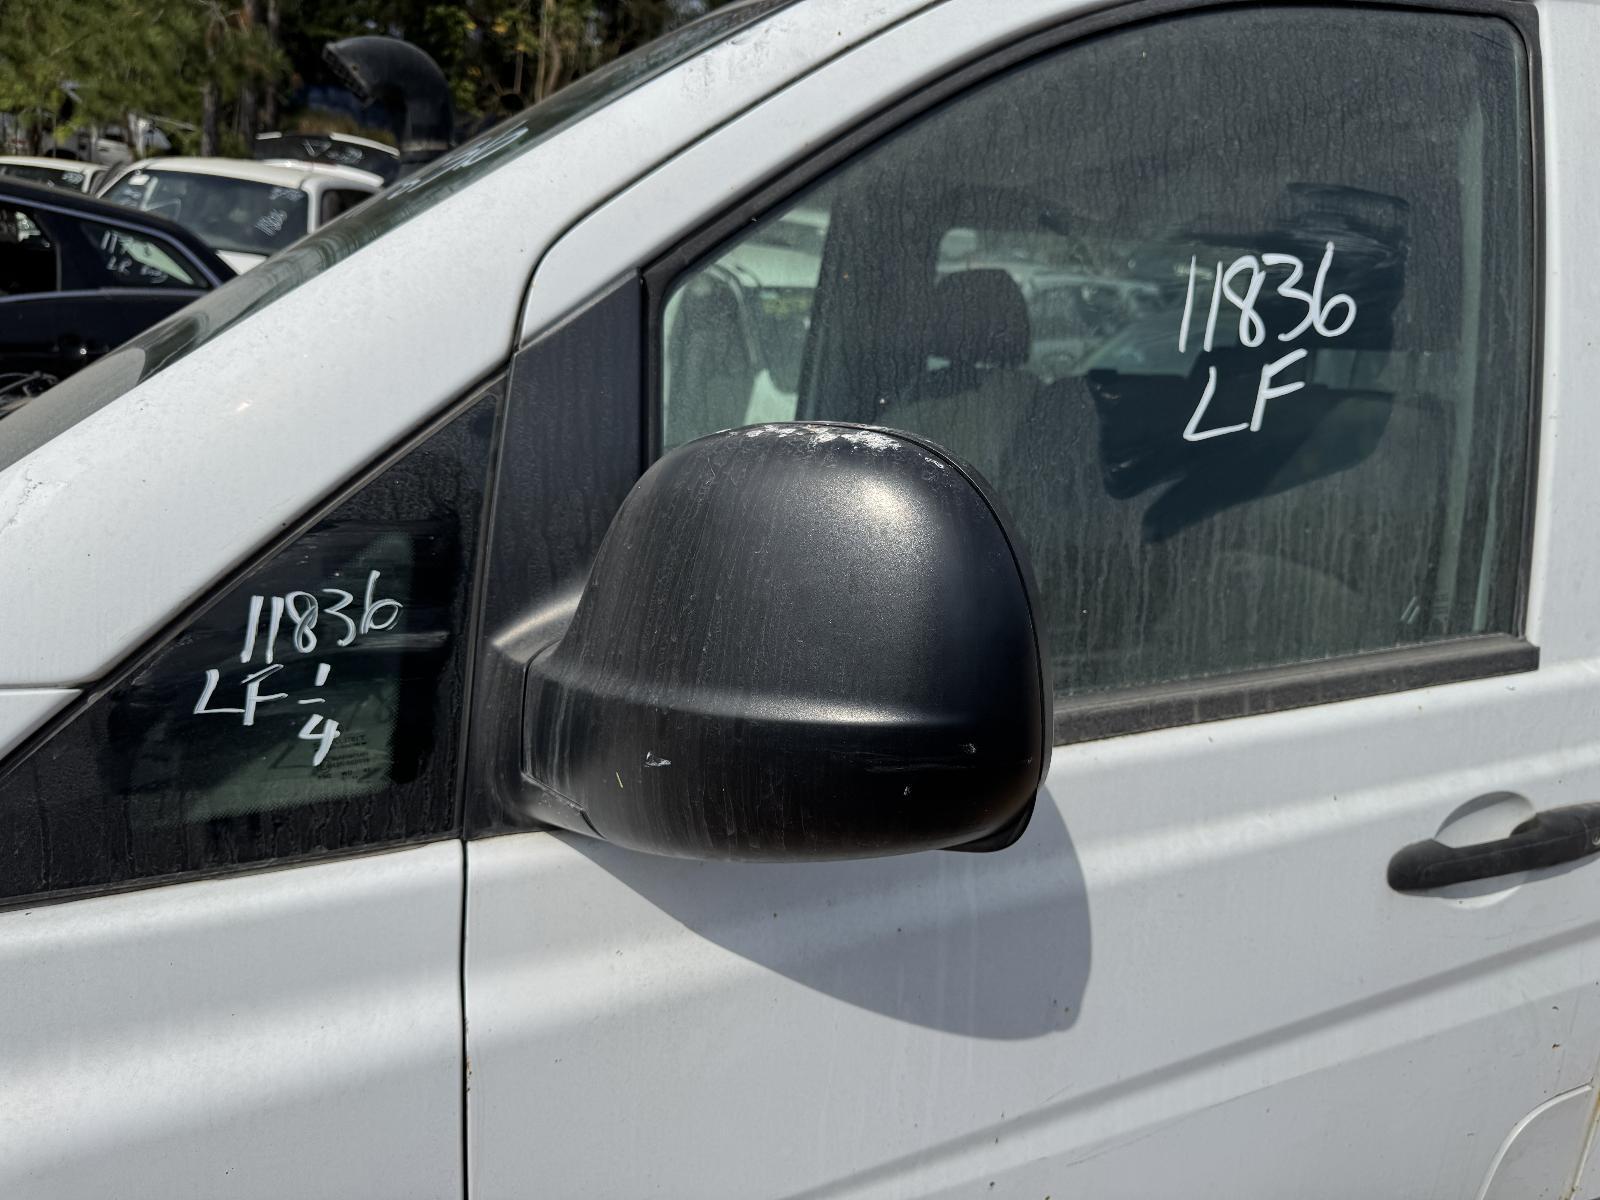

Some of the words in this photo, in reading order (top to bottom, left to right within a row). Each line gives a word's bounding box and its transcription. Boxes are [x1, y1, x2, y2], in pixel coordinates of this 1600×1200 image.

[1178, 241, 1357, 353] 11836
[1183, 349, 1308, 442] LF
[240, 570, 404, 664] 11836
[193, 664, 289, 726] LF
